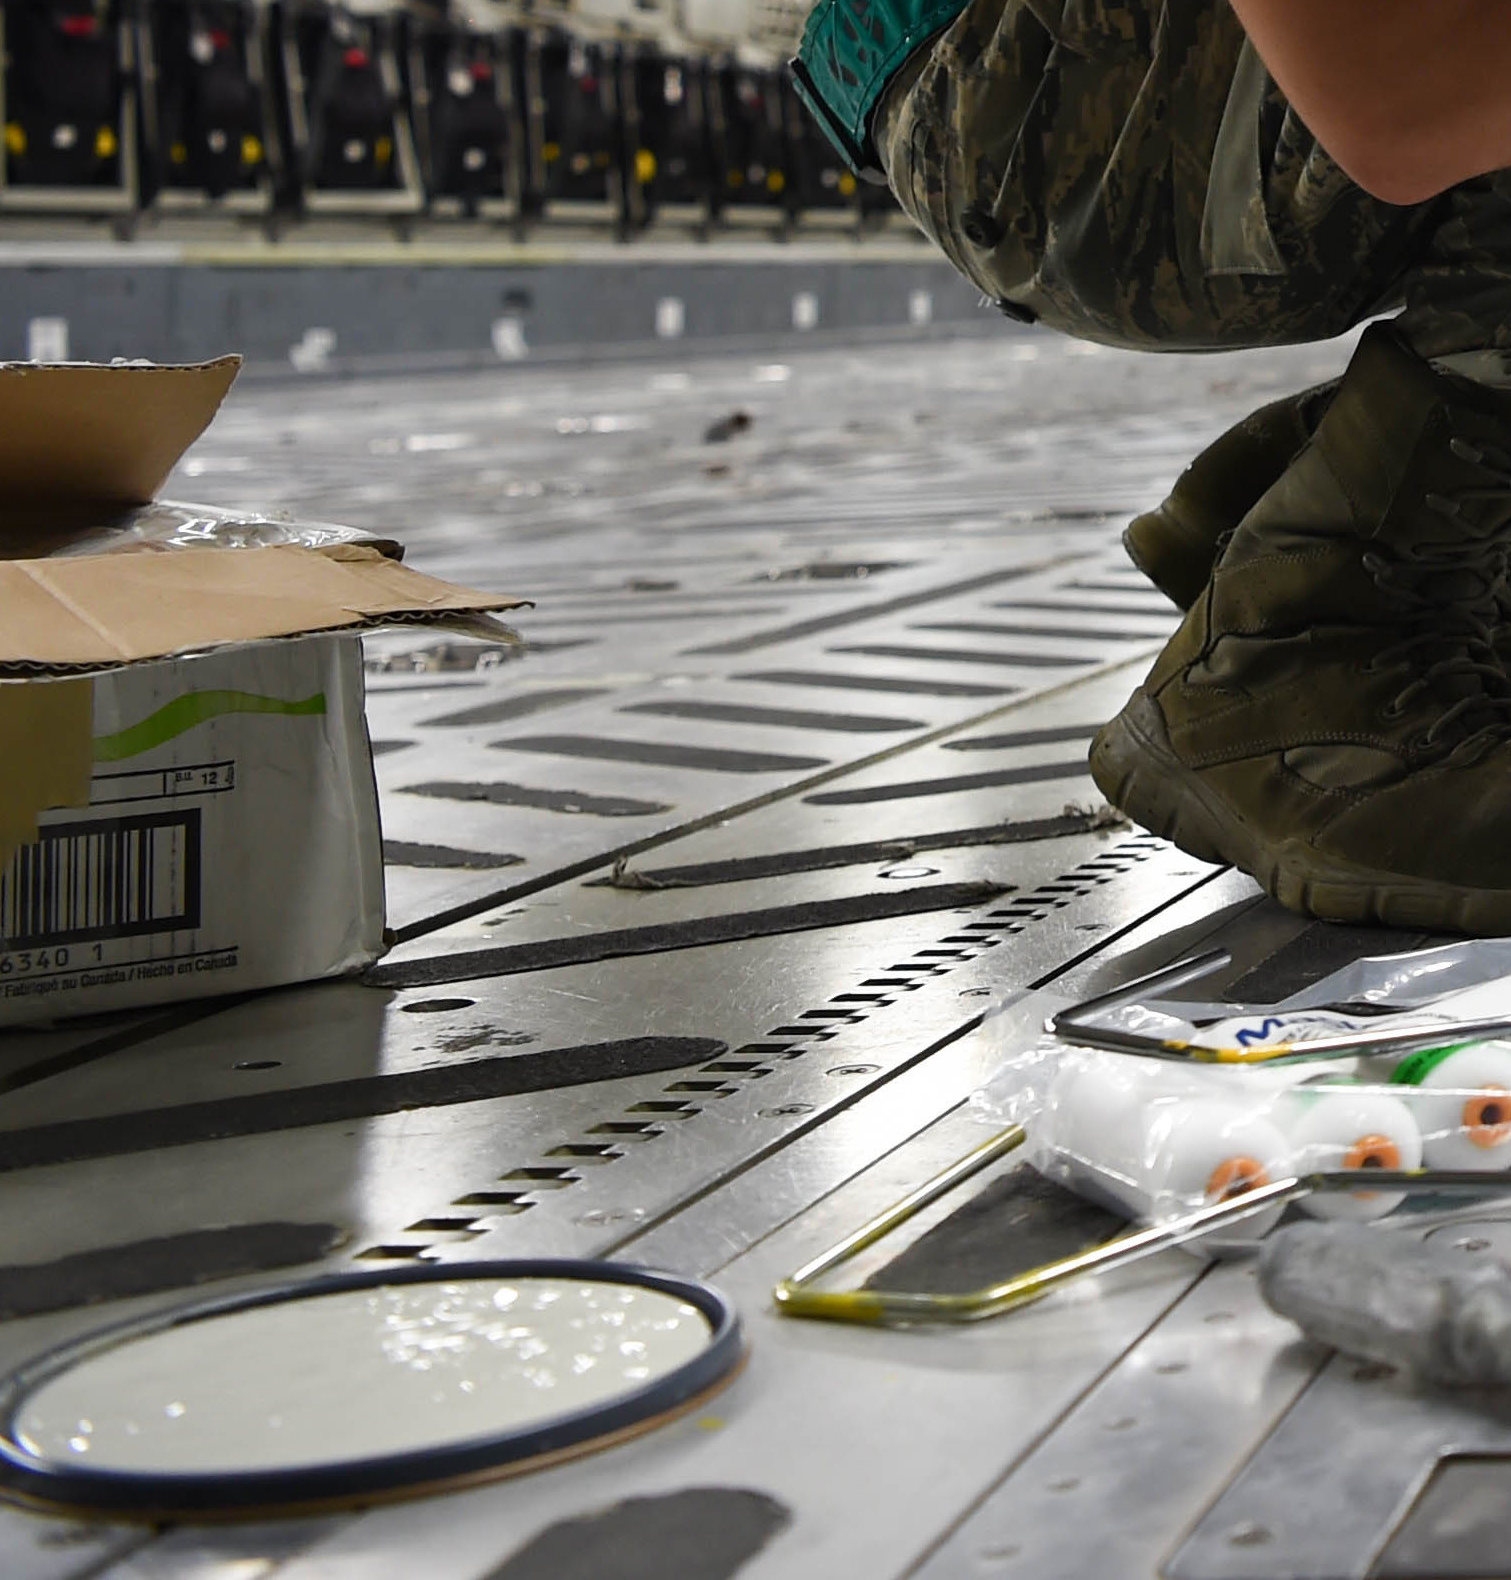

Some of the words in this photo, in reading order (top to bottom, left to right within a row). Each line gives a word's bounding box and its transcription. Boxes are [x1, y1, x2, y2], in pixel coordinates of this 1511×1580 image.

[201, 771, 218, 786] 12
[61, 978, 78, 991] au
[80, 969, 126, 988] Canada
[137, 962, 176, 980] Hecho
[177, 962, 194, 974] en
[195, 953, 238, 971] Canada
